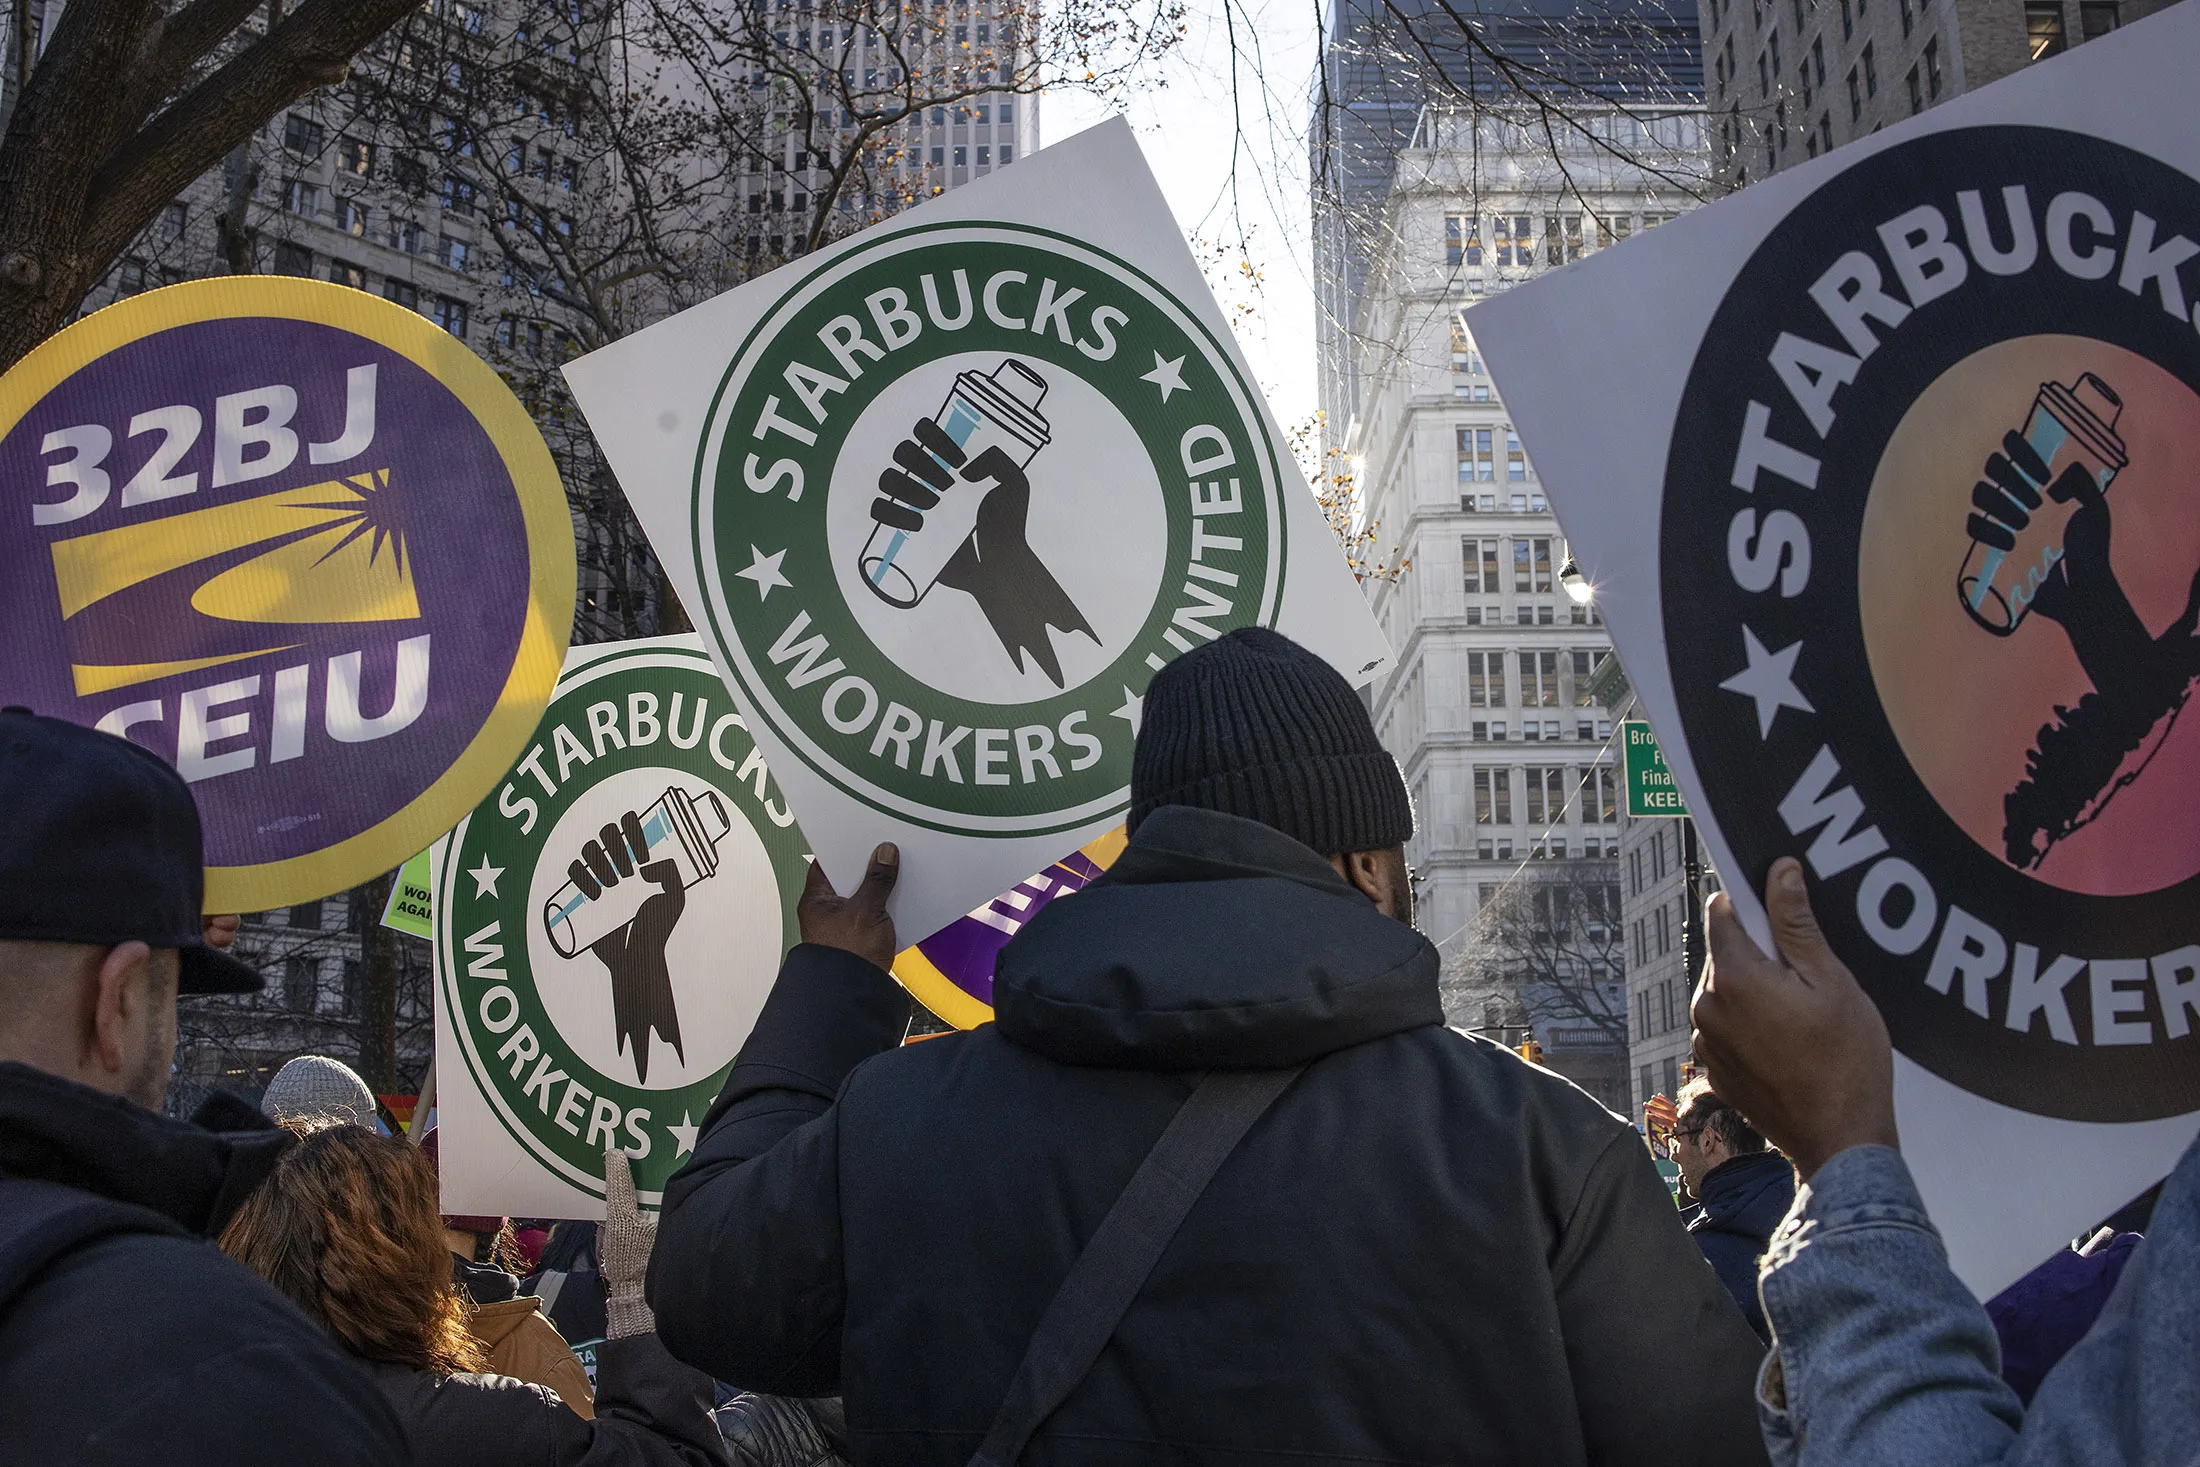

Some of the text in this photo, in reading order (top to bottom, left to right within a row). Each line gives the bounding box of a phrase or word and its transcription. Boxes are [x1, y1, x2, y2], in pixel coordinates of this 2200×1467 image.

[33, 363, 378, 526] 32BJ
[744, 268, 1130, 503] STARBUCKS
[1728, 185, 2200, 597] STARBUCK
[767, 609, 1103, 784] WORKERS
[396, 901, 432, 921] AGAI
[1778, 751, 2200, 1046] WORKER
[464, 919, 652, 1160] WORKERS
